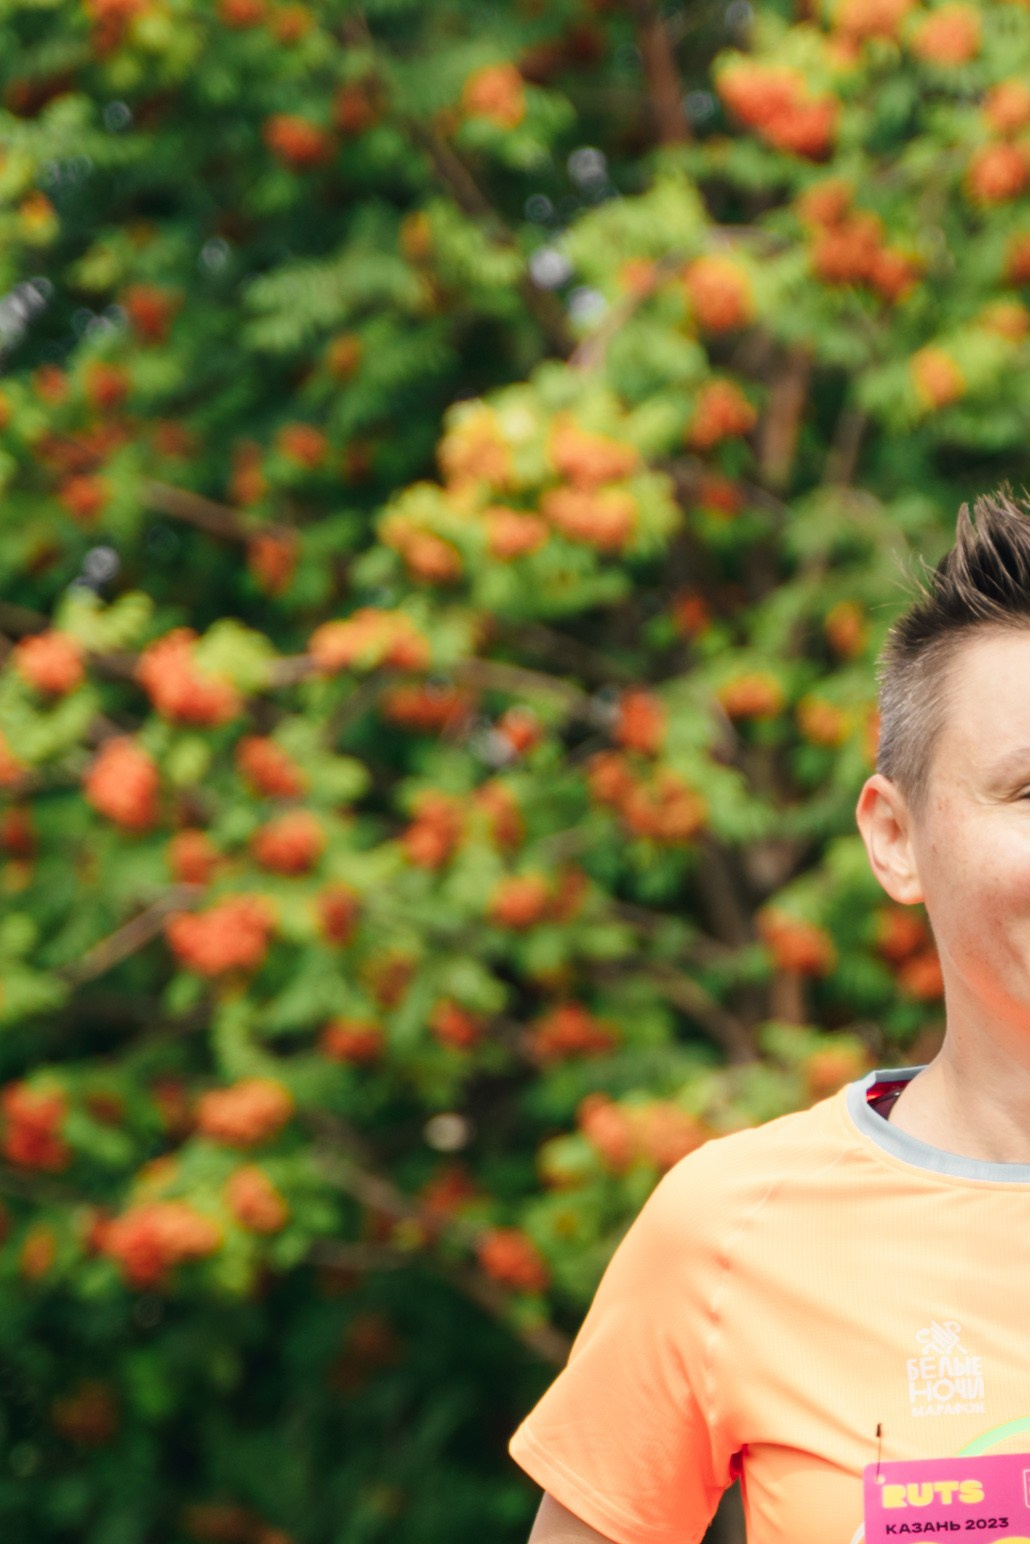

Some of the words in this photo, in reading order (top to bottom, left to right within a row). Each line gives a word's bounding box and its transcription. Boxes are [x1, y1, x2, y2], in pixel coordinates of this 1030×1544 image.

[906, 1355, 984, 1381] БЕЛЫЕ
[907, 1375, 985, 1404] НОЧИ
[881, 1479, 985, 1509] RUTS
[885, 1520, 961, 1535] КАЗАНЬ
[964, 1517, 1009, 1531] 2023
